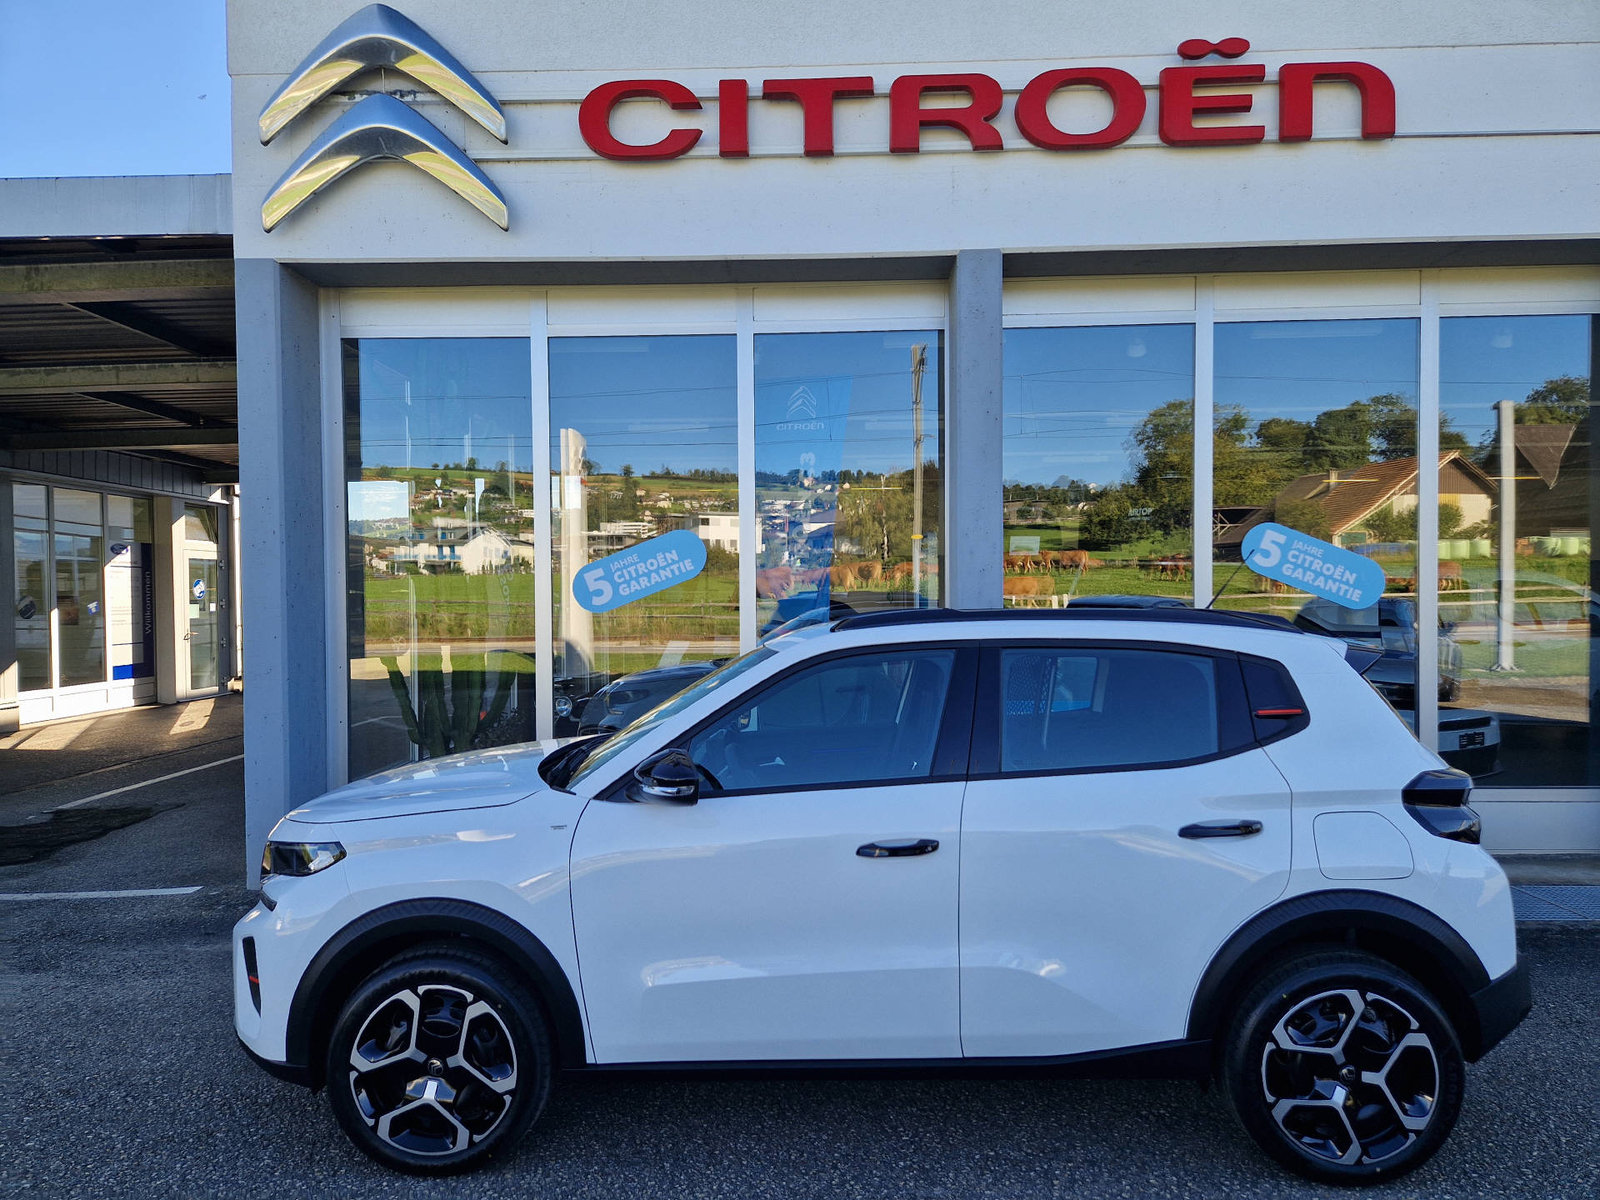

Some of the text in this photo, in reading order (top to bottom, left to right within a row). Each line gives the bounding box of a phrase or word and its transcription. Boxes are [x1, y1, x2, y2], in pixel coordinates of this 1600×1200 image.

[578, 37, 1396, 161] CITROËN
[609, 553, 640, 573] JAHRE
[613, 549, 679, 583] CITROËN
[1253, 529, 1287, 568] 5
[1287, 550, 1357, 585] CITROËN
[1292, 539, 1325, 558] JAHRE
[584, 568, 613, 606] 5
[618, 558, 695, 596] GARANTIE
[1282, 563, 1363, 602] GARANTIE
[144, 571, 152, 634] Willkommen
